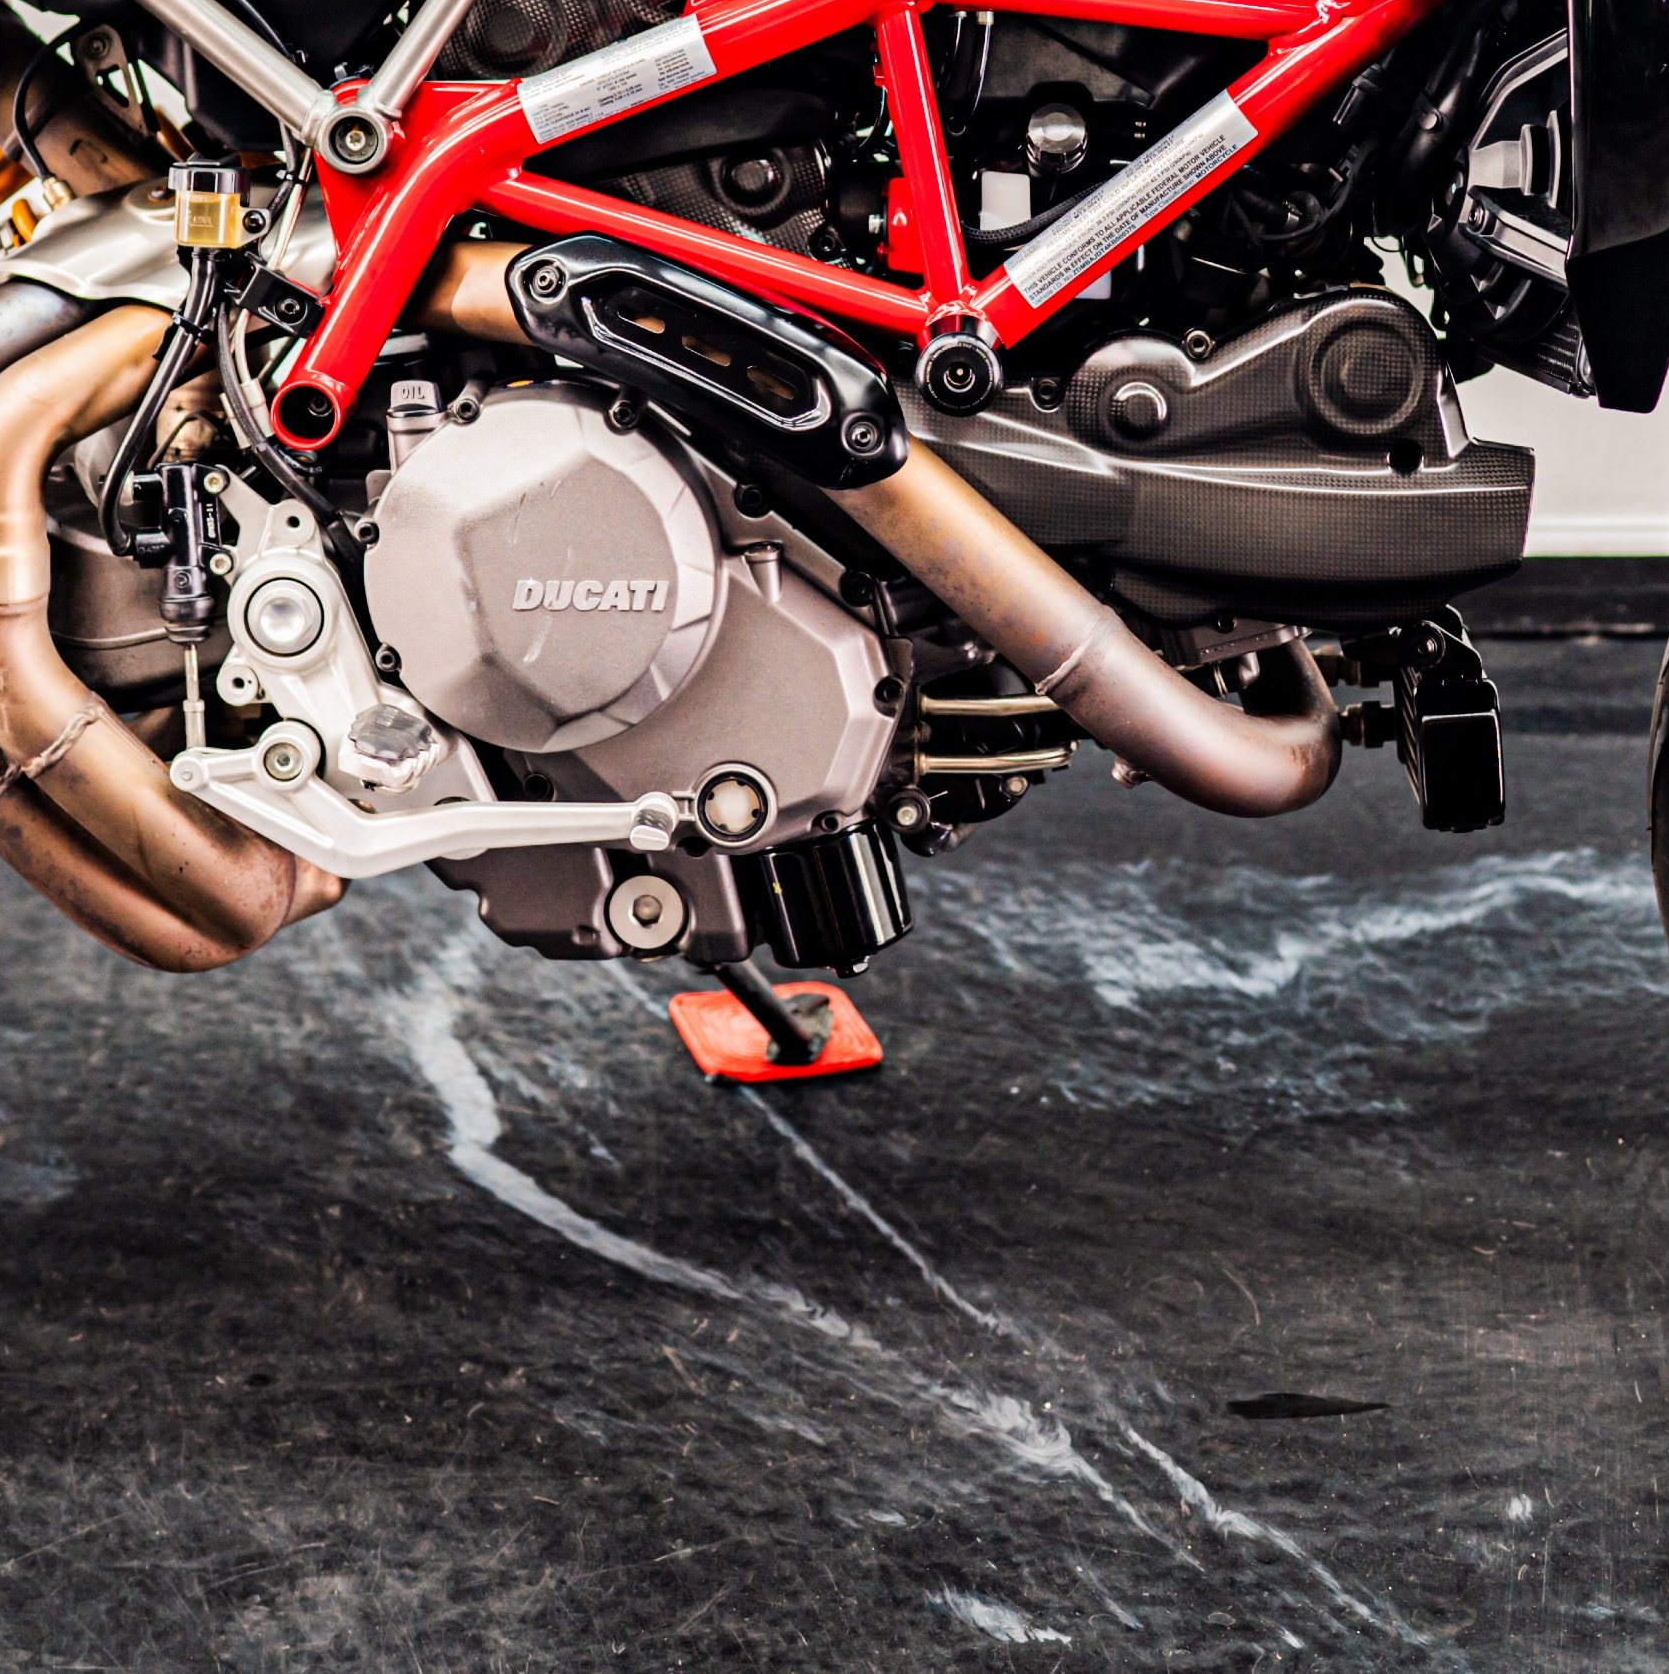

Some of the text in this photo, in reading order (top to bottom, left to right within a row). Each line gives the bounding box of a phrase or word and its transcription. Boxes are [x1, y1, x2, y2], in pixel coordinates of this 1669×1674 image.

[1022, 280, 1039, 294] THIS
[1036, 261, 1063, 284] VEHICLE
[1060, 235, 1097, 265] CONFORMS
[1094, 228, 1105, 239] TO
[1102, 219, 1117, 232] ALL
[1114, 191, 1153, 223] APPLICABLE
[1150, 170, 1180, 195] FEDERAL
[1177, 153, 1201, 174] MOTOR
[1198, 133, 1226, 157] VEHICLE
[1143, 205, 1160, 220] Type
[1193, 142, 1239, 179] MOTORCYCLE
[1027, 269, 1065, 301] STANDARDS
[1062, 264, 1072, 274] IN
[1069, 247, 1094, 268] EFFECT
[1091, 239, 1104, 251] ON
[1100, 230, 1116, 243] THE
[1113, 217, 1132, 234] DATE
[1129, 211, 1140, 222] OF
[1137, 177, 1184, 215] MANUFACTURE
[1181, 159, 1206, 181] SHOWN
[1203, 143, 1227, 163] ABOVE
[401, 386, 425, 399] OIL
[512, 580, 670, 611] DUCATI
